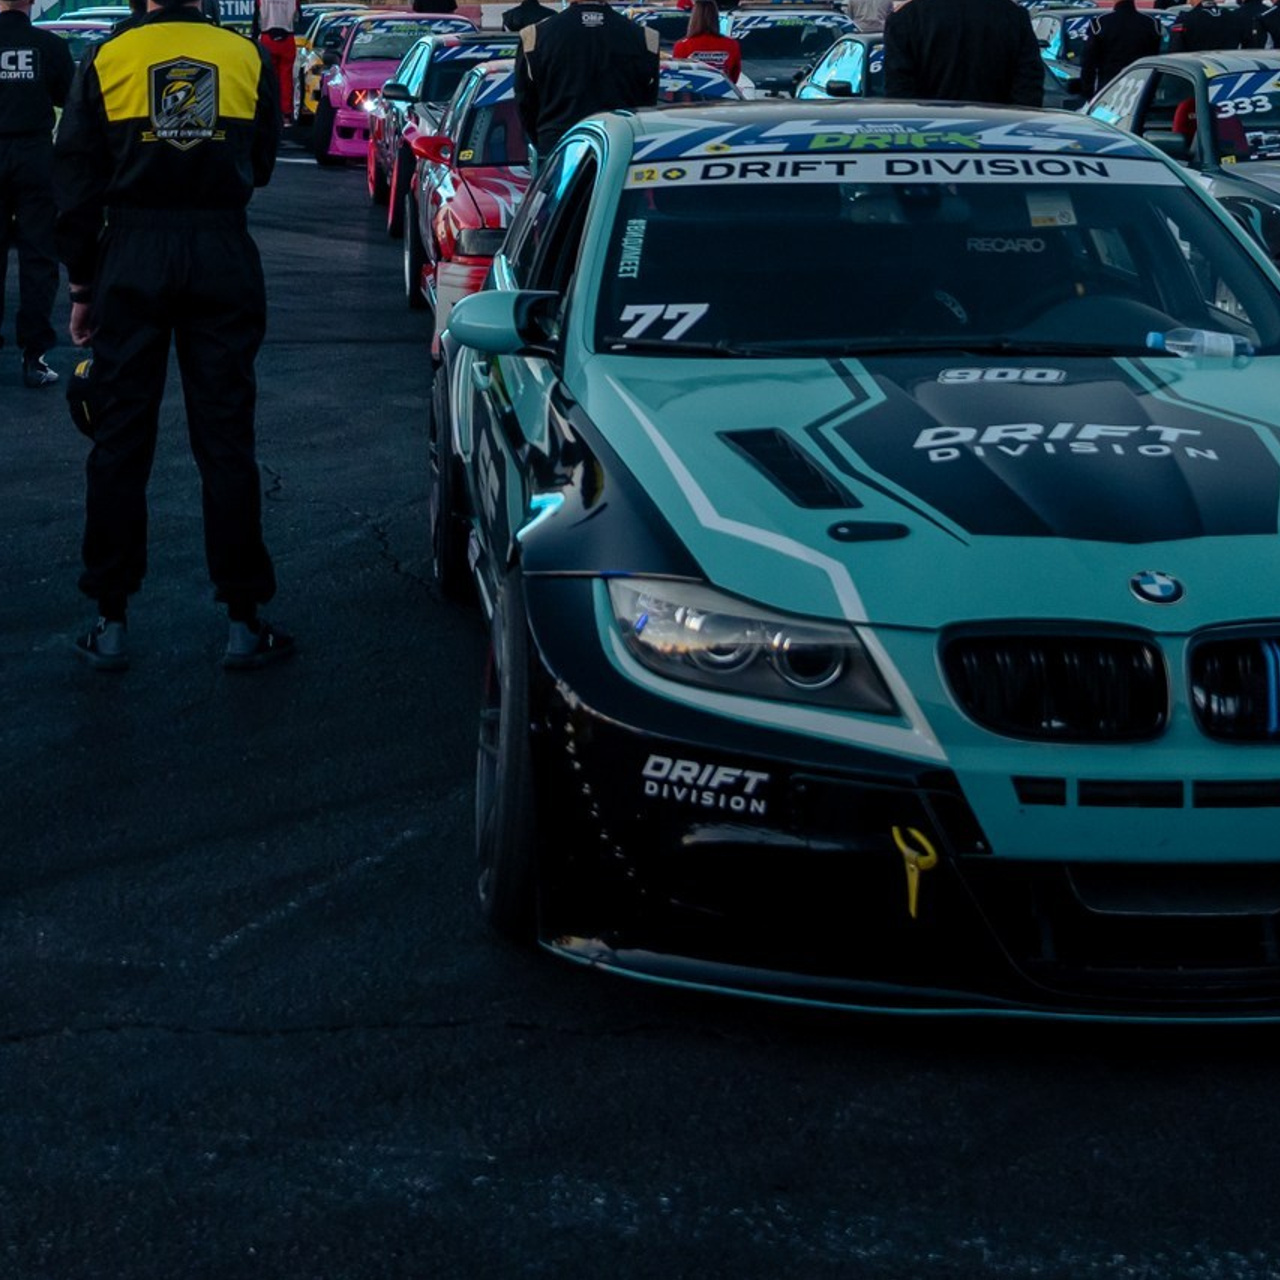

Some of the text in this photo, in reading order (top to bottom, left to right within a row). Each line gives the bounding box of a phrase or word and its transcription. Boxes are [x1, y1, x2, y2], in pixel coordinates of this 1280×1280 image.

[1217, 95, 1272, 118] 333
[700, 158, 1111, 180] DRIFT DIVISION
[967, 237, 1045, 253] RECARO
[620, 303, 710, 341] 77
[937, 368, 1067, 384] 900
[913, 423, 1202, 448] DRIFT
[928, 442, 1218, 462] DIVISION
[642, 754, 769, 794] DRIFT
[645, 780, 766, 815] DIVISION
